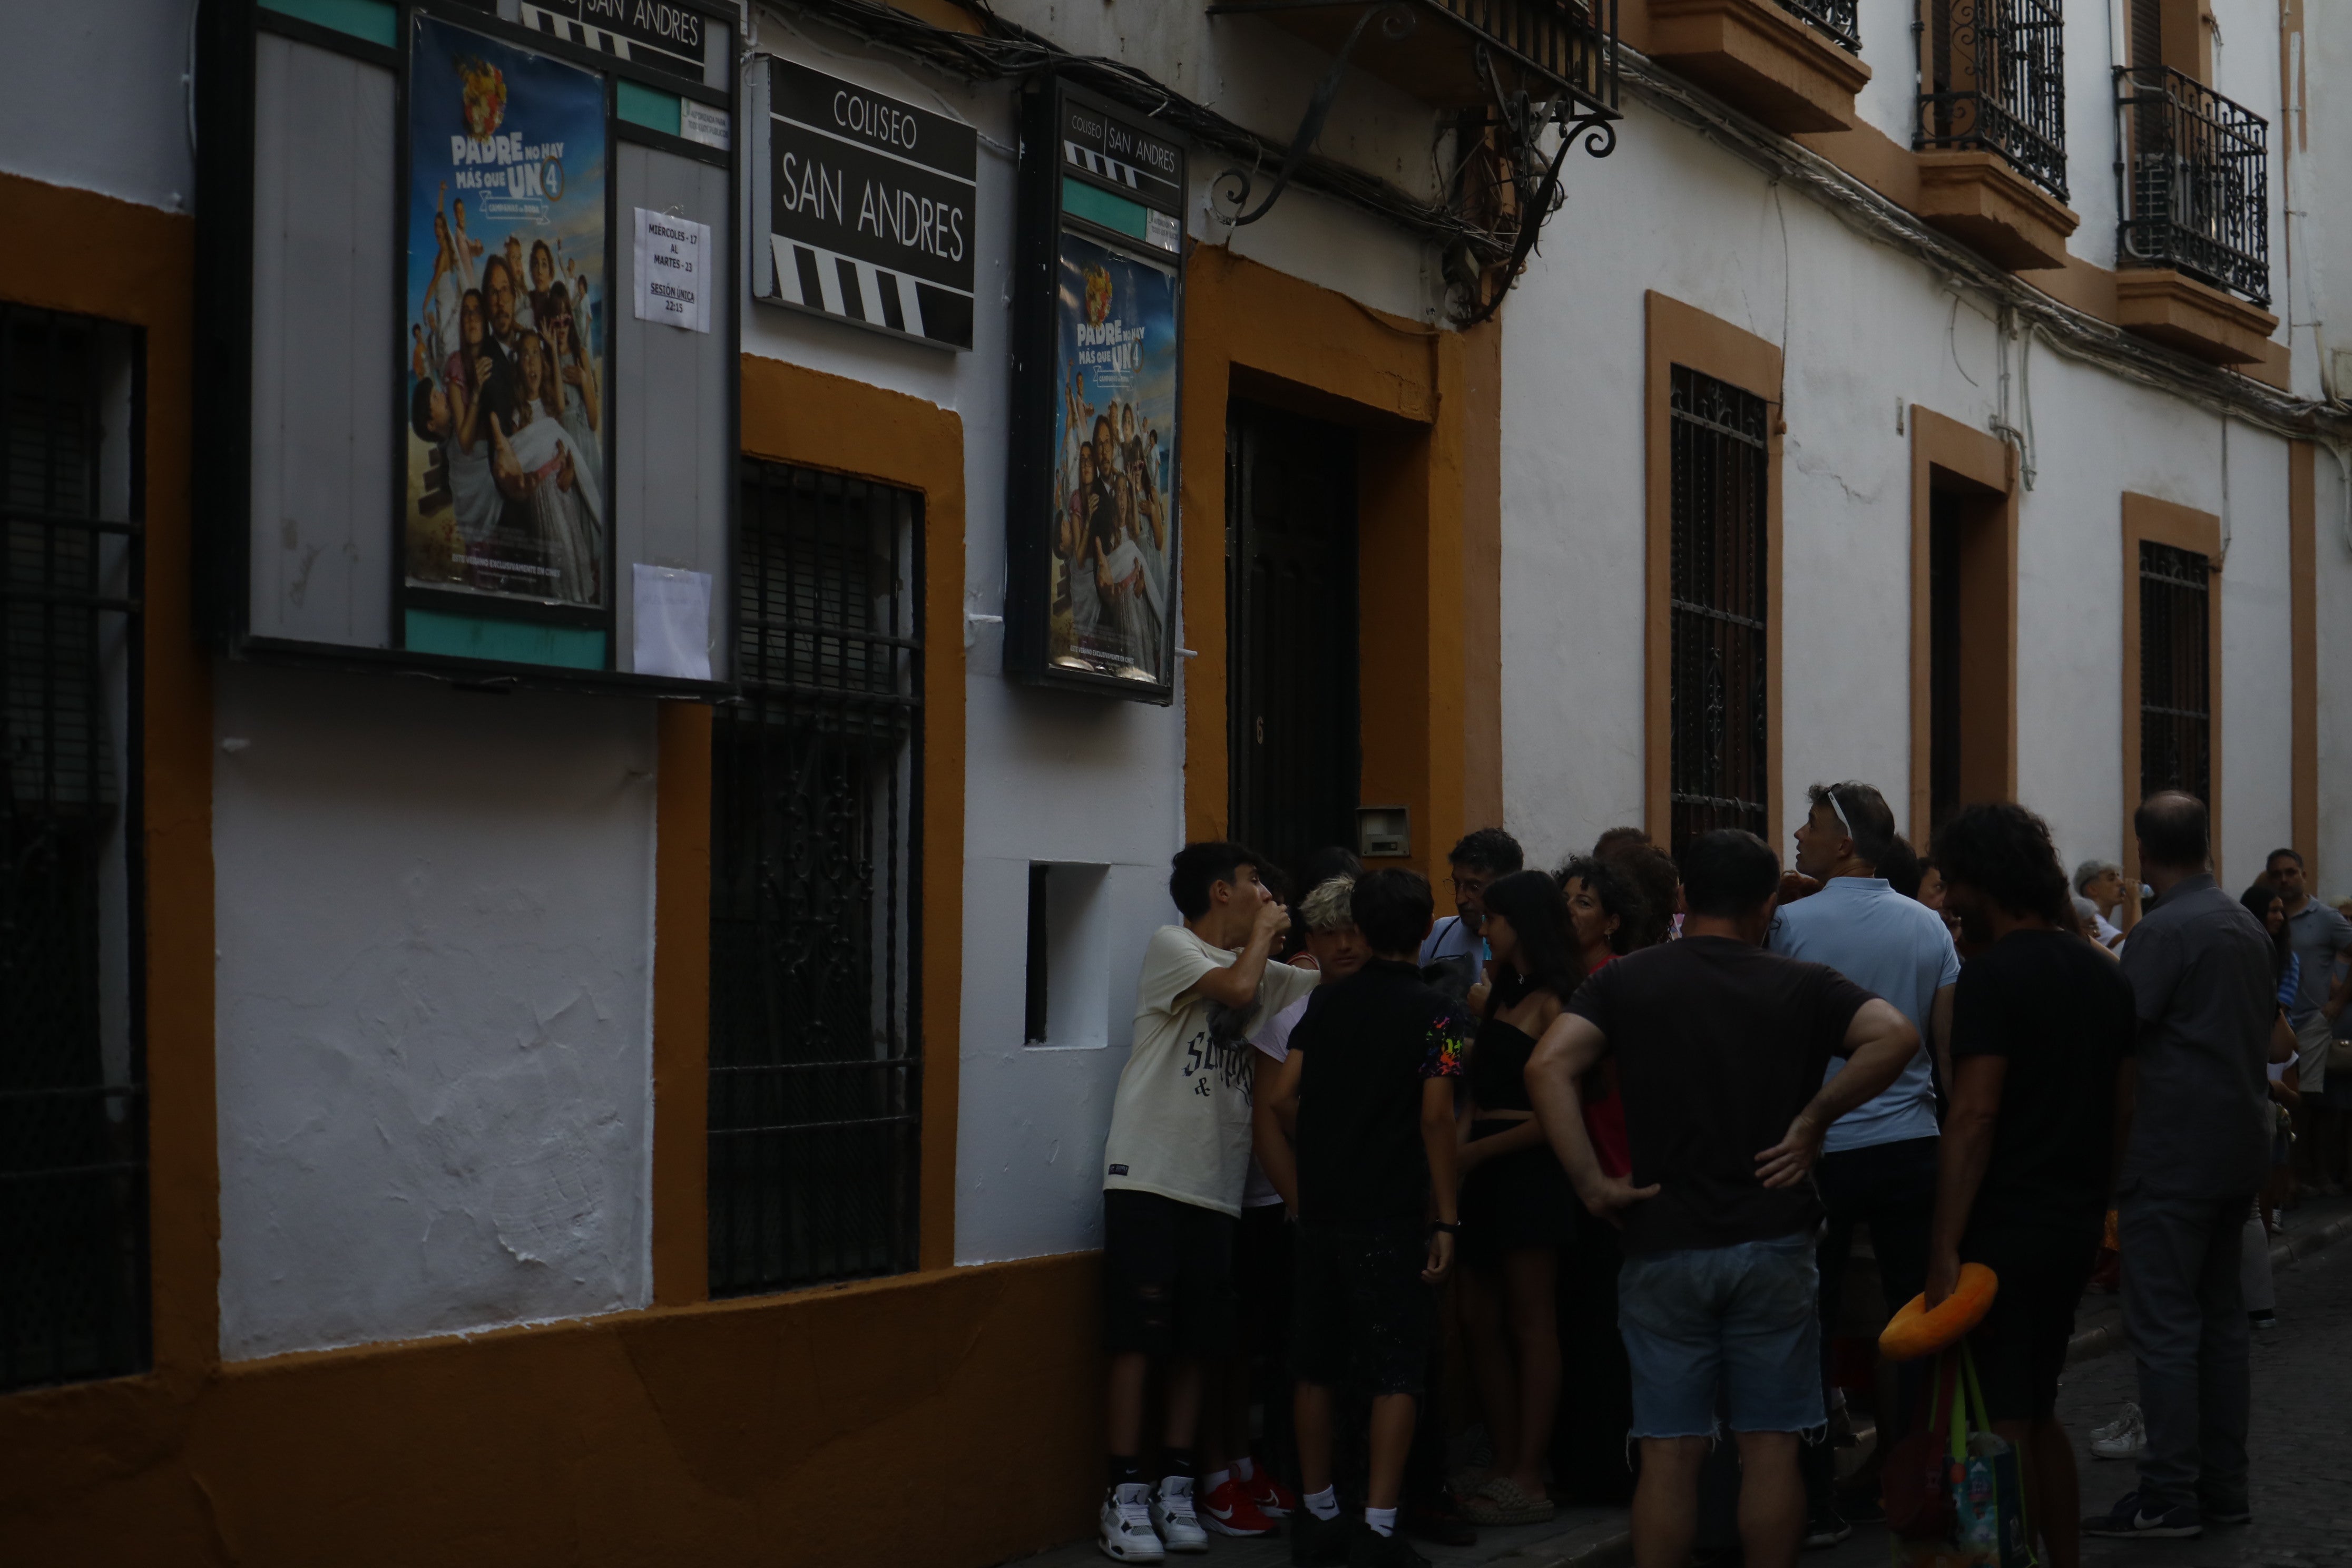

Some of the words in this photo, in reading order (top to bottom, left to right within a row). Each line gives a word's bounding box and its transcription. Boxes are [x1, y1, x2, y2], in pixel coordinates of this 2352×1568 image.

[633, 0, 698, 46] ANDRES
[834, 90, 917, 150] COLISEO
[450, 131, 523, 166] PADRE
[525, 146, 540, 160] NO
[541, 142, 564, 159] HAY
[1072, 115, 1102, 140] COLISEO
[1109, 127, 1131, 155] SAN
[1136, 139, 1174, 173] ANDRES
[455, 168, 482, 189] MÁS
[483, 171, 506, 187] QUE
[506, 162, 543, 198] UN
[545, 164, 557, 193] 4
[782, 152, 842, 227] SAN
[857, 178, 964, 262] ANDRES
[649, 223, 685, 242] MIÉRCOLES
[690, 235, 697, 245] 17
[670, 243, 678, 254] AL
[654, 254, 680, 269] MARTES
[685, 261, 692, 272] 23
[650, 282, 675, 297] SESIÓN
[677, 286, 694, 302] ÚNICA
[665, 300, 683, 313] 22:15
[1077, 319, 1122, 347] PADRE
[1123, 330, 1131, 341] NO
[1131, 327, 1145, 340] HAY
[1079, 348, 1095, 365] MÁS
[1096, 350, 1111, 364] QUE
[1112, 342, 1132, 371] UN
[1133, 344, 1139, 366] 4
[1256, 716, 1264, 744] 6
